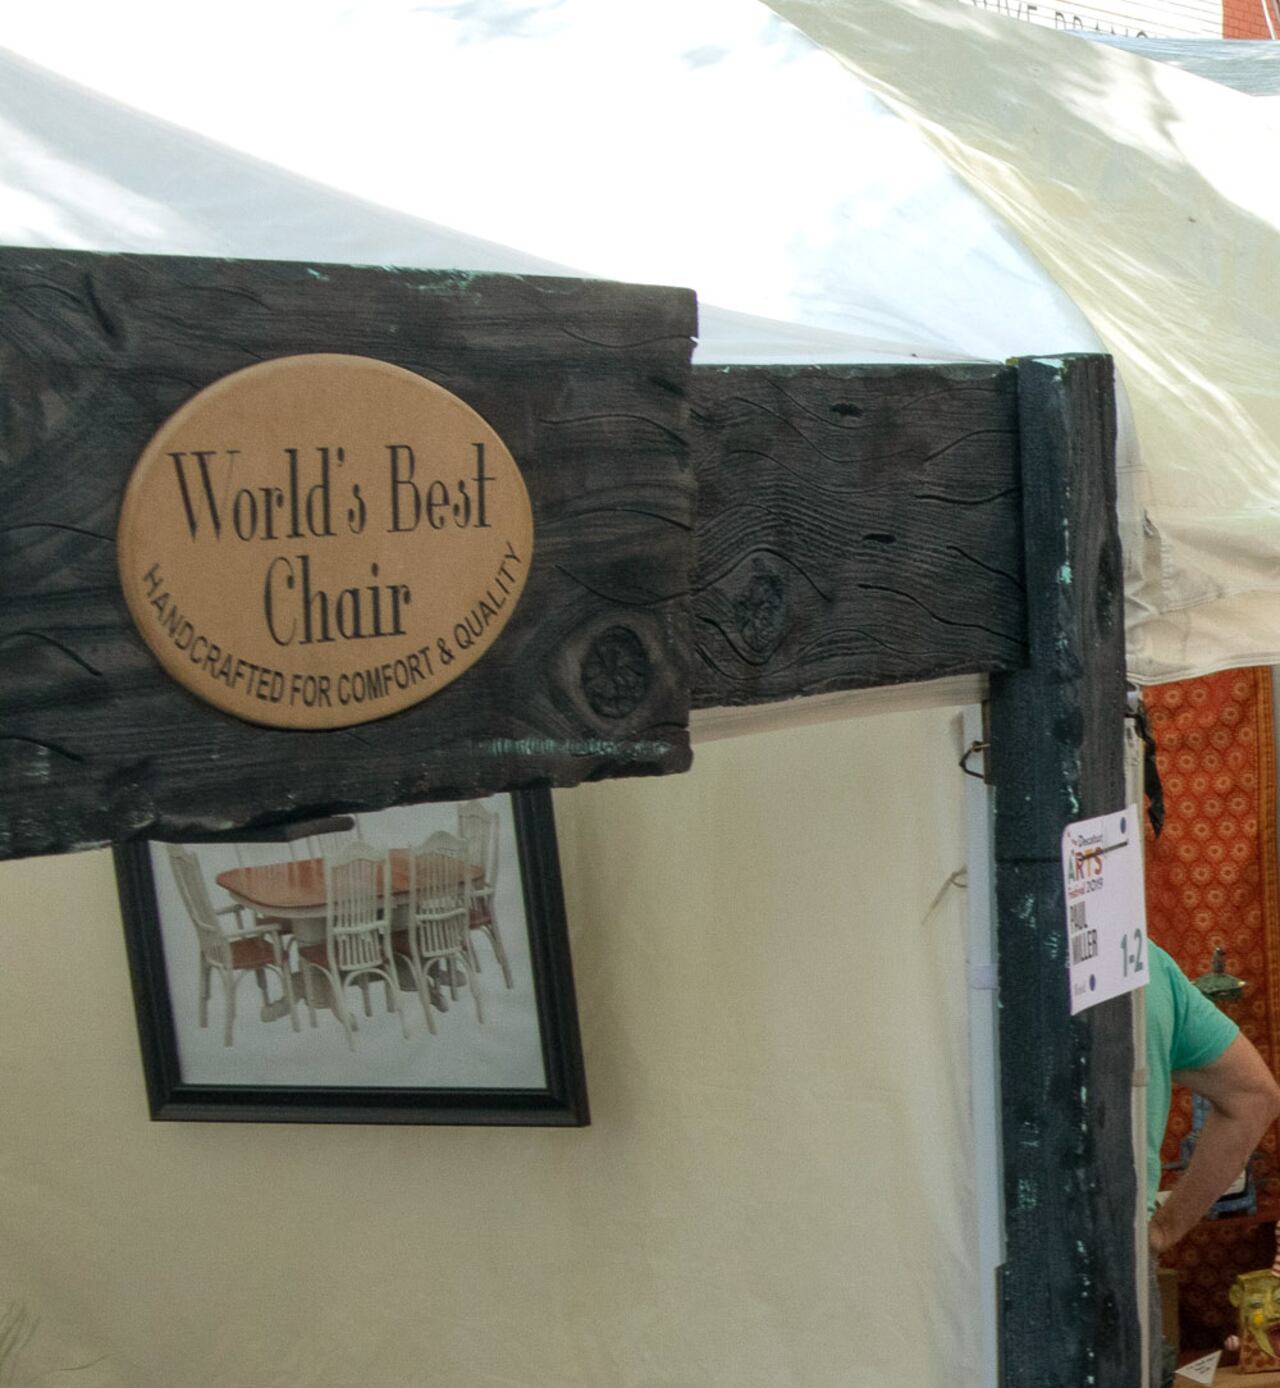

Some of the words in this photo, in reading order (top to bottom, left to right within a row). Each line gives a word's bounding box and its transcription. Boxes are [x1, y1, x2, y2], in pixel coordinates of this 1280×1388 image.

[166, 446, 367, 542] World's
[385, 442, 497, 533] Best
[143, 562, 286, 706] HANDCRAFTED
[290, 672, 333, 708] FOR
[337, 646, 435, 706] COMFORT
[436, 637, 456, 666] &
[453, 541, 523, 650] QUALITY
[263, 554, 412, 647] Chair
